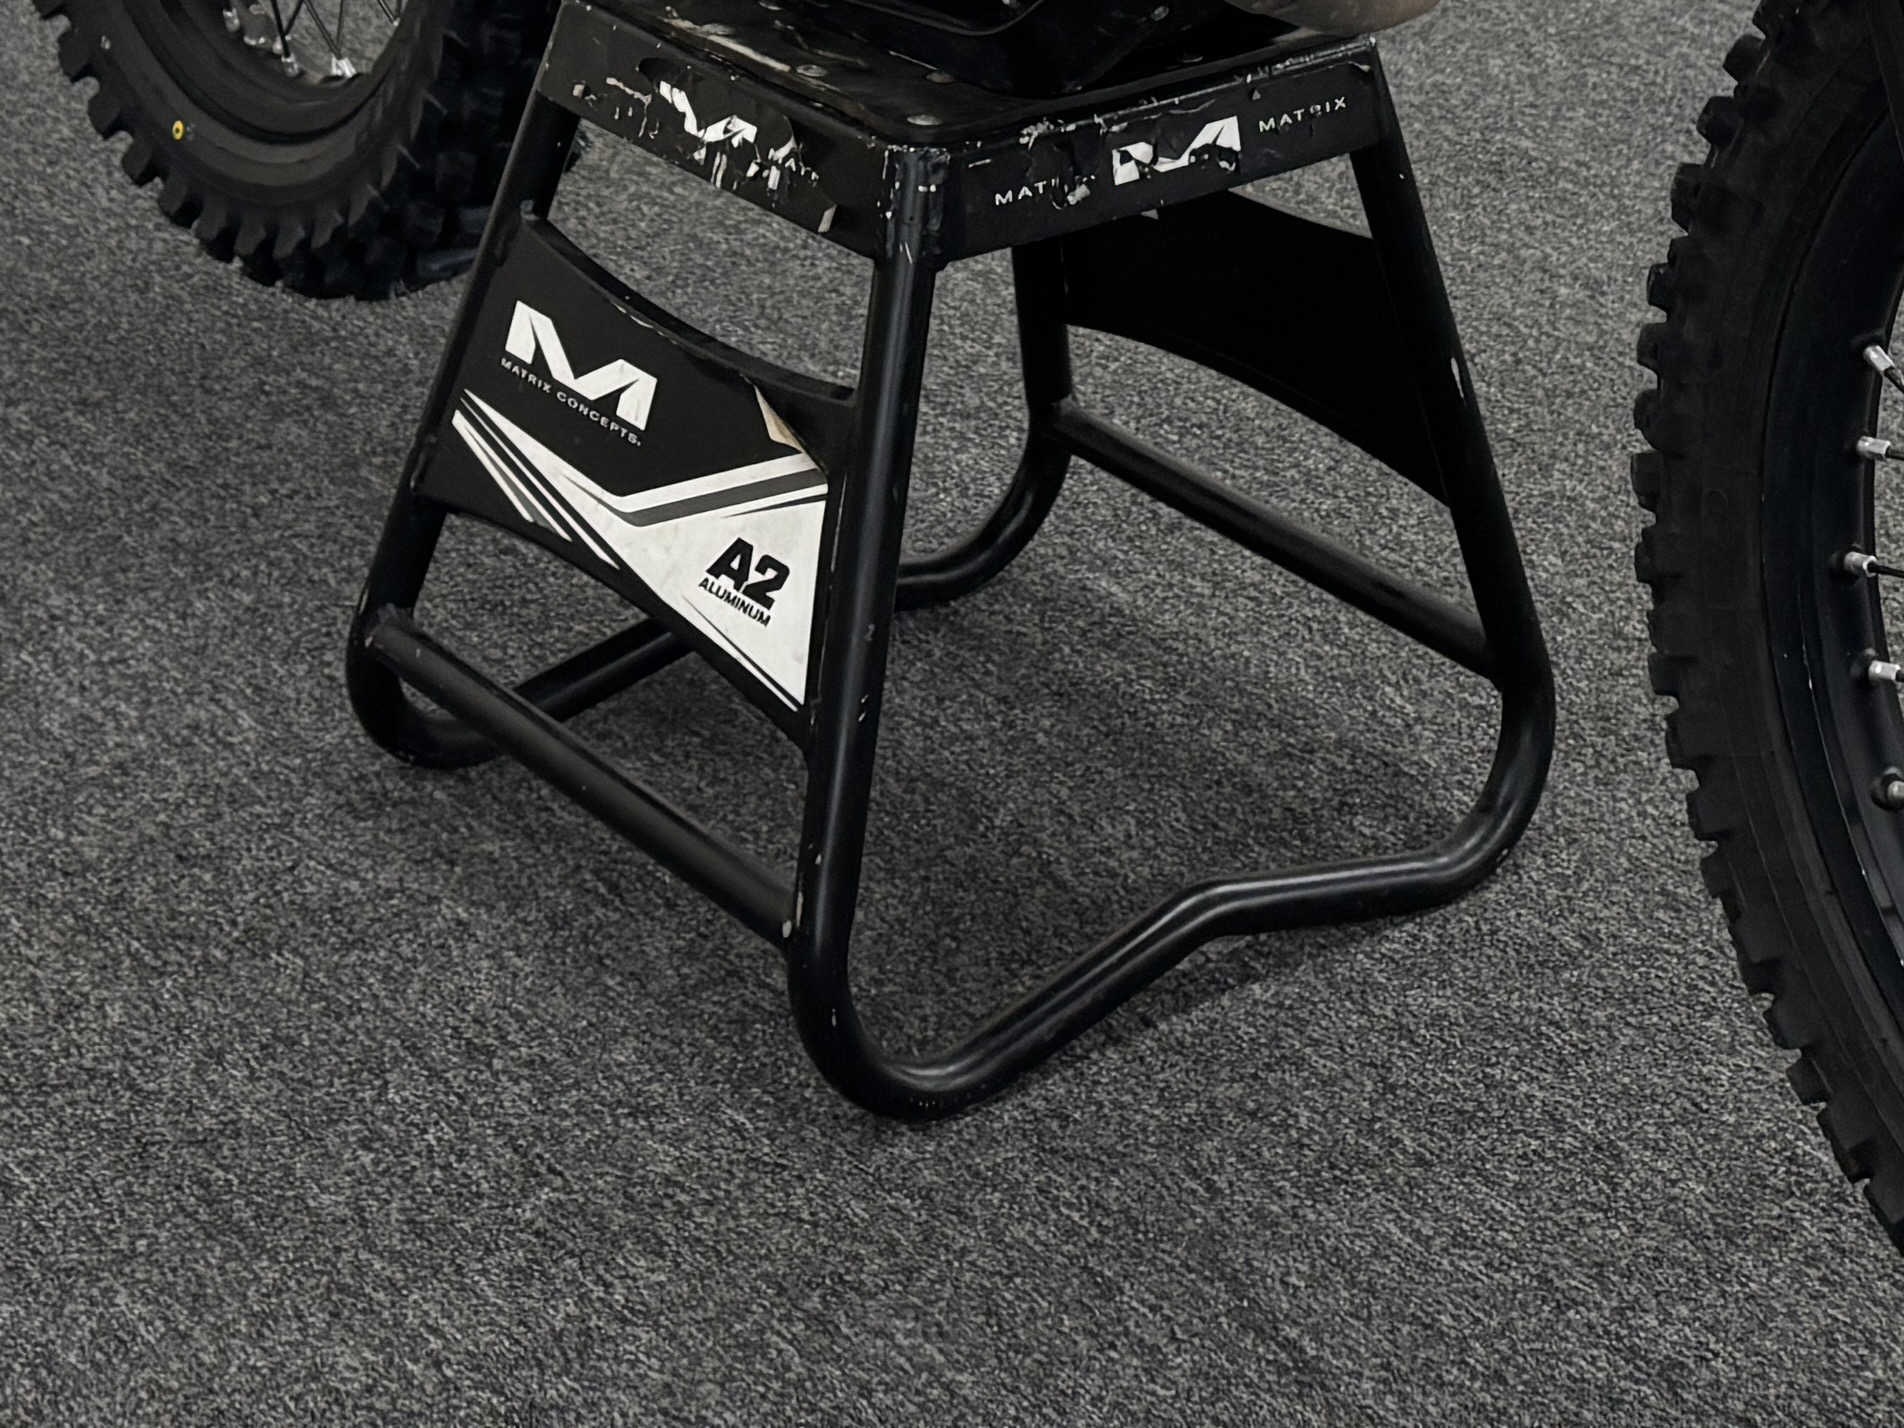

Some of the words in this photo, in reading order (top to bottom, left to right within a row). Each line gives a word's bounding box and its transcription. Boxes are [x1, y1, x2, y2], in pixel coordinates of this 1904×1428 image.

[1258, 95, 1348, 134] MATRIX
[500, 356, 553, 396] MATRIX
[706, 536, 790, 611] A2
[698, 577, 772, 628] ALUMINUM
